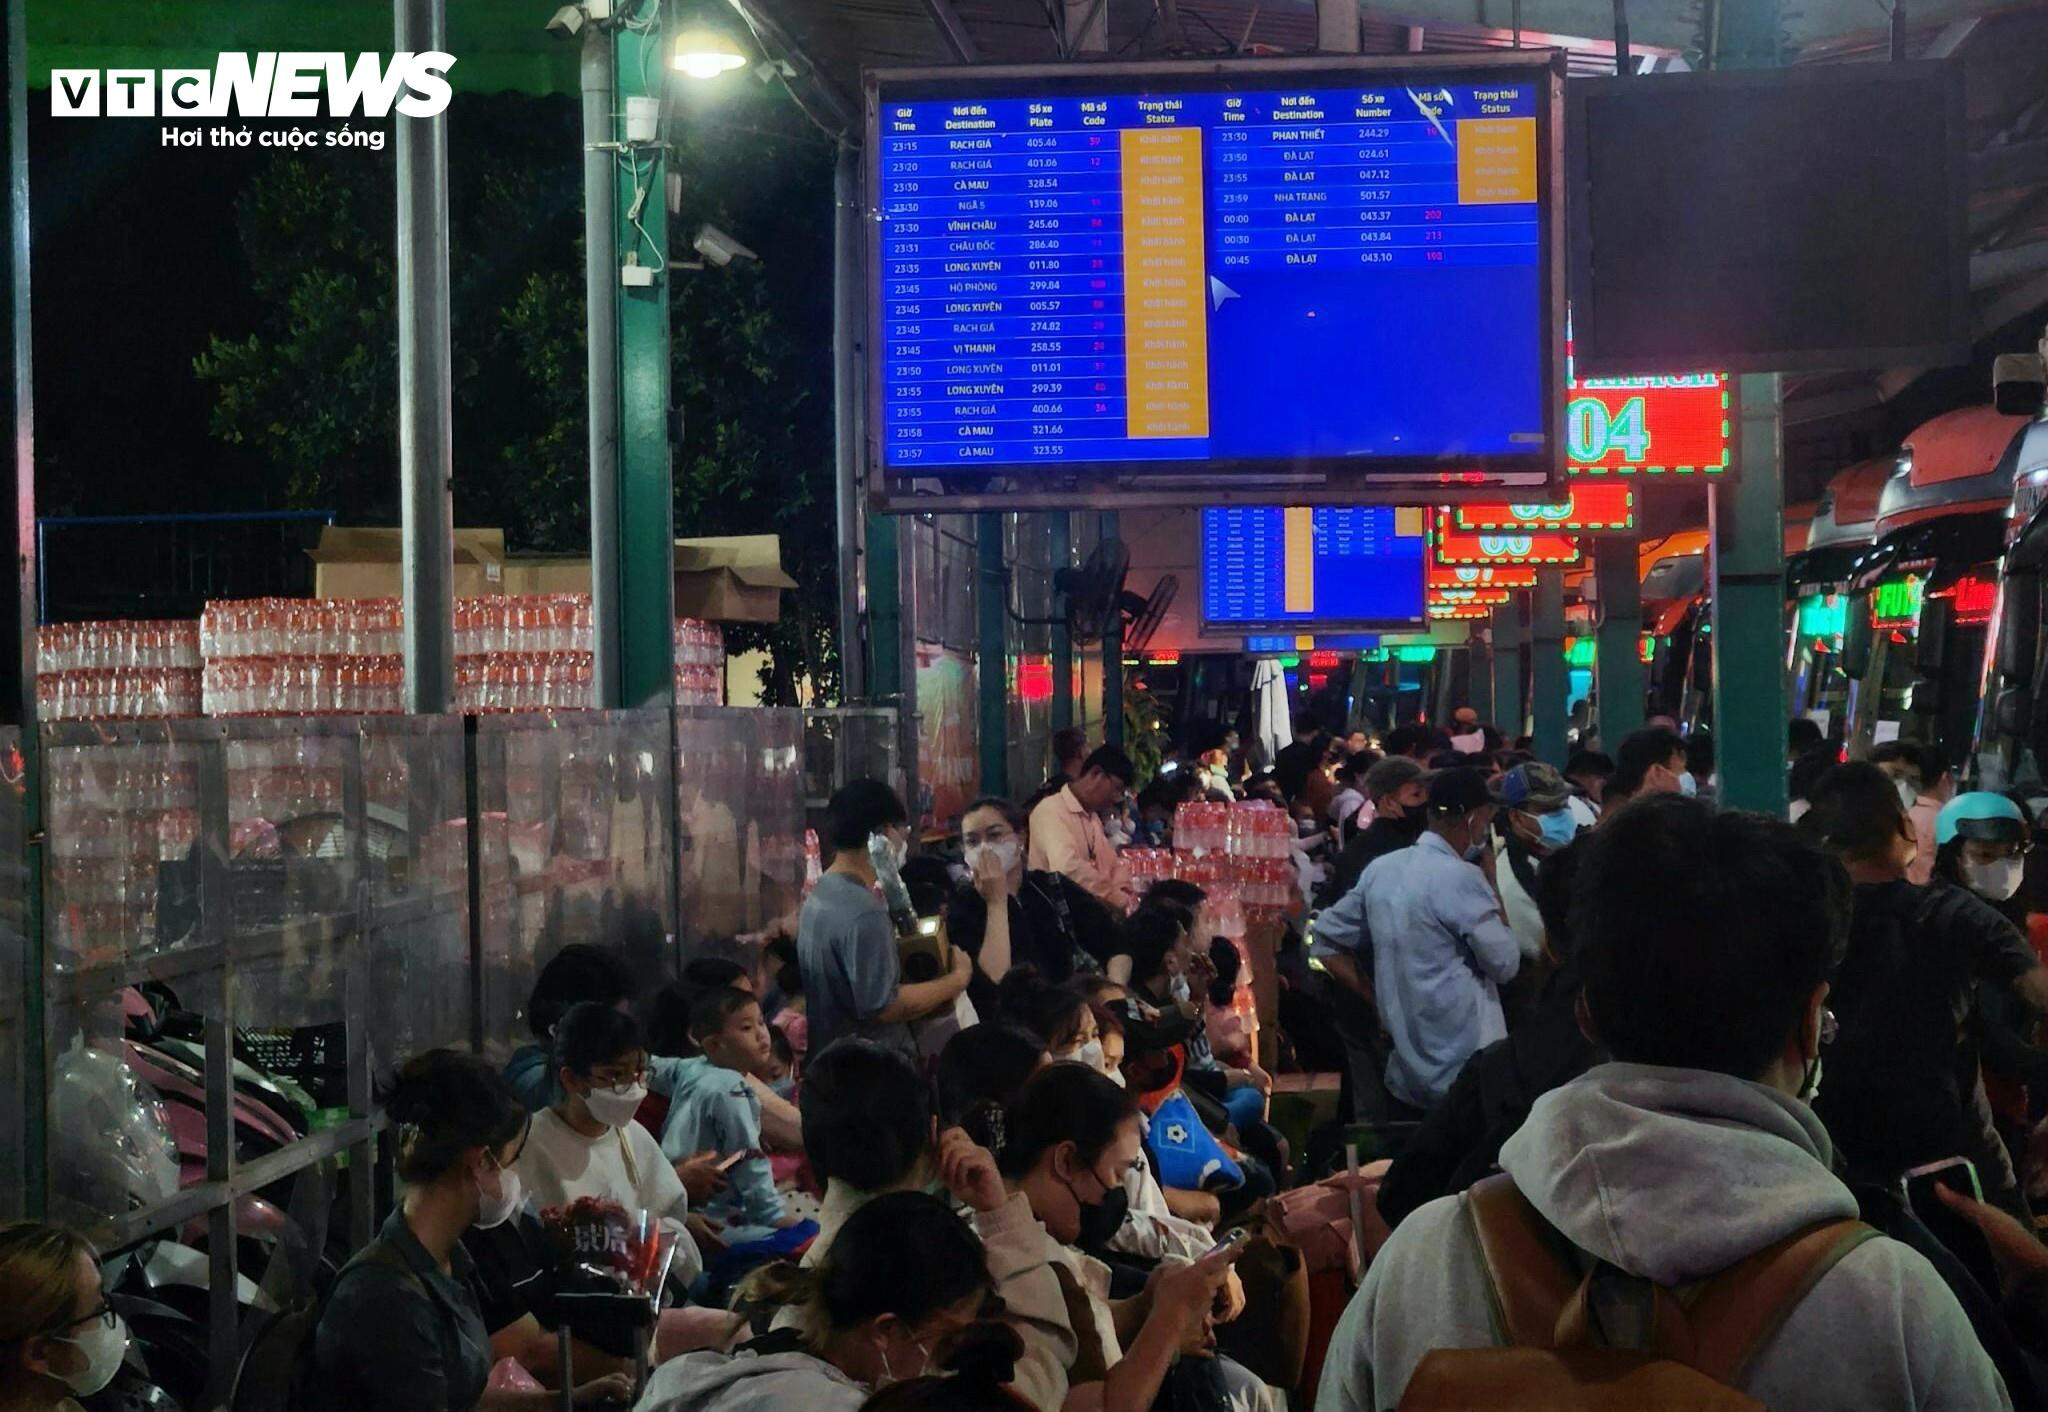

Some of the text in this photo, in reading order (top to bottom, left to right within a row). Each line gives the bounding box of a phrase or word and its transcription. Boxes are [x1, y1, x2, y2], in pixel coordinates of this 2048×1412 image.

[1362, 94, 1373, 104] Số
[1473, 89, 1518, 101] Trạng thái
[1138, 100, 1182, 112] Trạng thái
[1226, 98, 1242, 108] Giờ
[1281, 96, 1315, 106] Nơi đến
[954, 106, 987, 115] Nơi đến
[1029, 104, 1041, 114] Số
[1081, 101, 1107, 113] Mã số
[1482, 104, 1510, 113] Status
[897, 108, 912, 118] Giờ
[1223, 112, 1245, 121] Time
[1273, 110, 1324, 120] Destination
[1356, 108, 1391, 118] Number
[1030, 118, 1052, 127] Plate
[1083, 116, 1106, 126] Code
[1146, 114, 1175, 124] Status
[945, 120, 995, 129] Destination
[1273, 128, 1325, 140] PHAN THIẾT
[950, 139, 992, 152] RẠCH GIÁ
[1284, 151, 1297, 160] ĐÀ
[976, 159, 992, 169] GIÁ
[1285, 172, 1297, 181] ĐÀ
[954, 181, 988, 190] CÀ MAU
[1285, 213, 1298, 222] ĐÀ
[972, 220, 996, 230] CHÂU
[1286, 234, 1299, 242] ĐÀ
[1286, 254, 1300, 263] ĐÀ
[945, 261, 1001, 272] LONG XUYÊN
[946, 301, 1001, 312] LONG XUYÊN
[979, 322, 995, 332] GIÁ
[964, 344, 995, 352] THANH
[947, 363, 1002, 374] LONG XUYÊN
[947, 384, 1003, 395] LONG XUYÊN
[981, 405, 996, 414] GIÁ
[958, 425, 993, 435] CÀ MAU
[1568, 397, 1651, 462] 04
[959, 447, 993, 456] CÀ MAU
